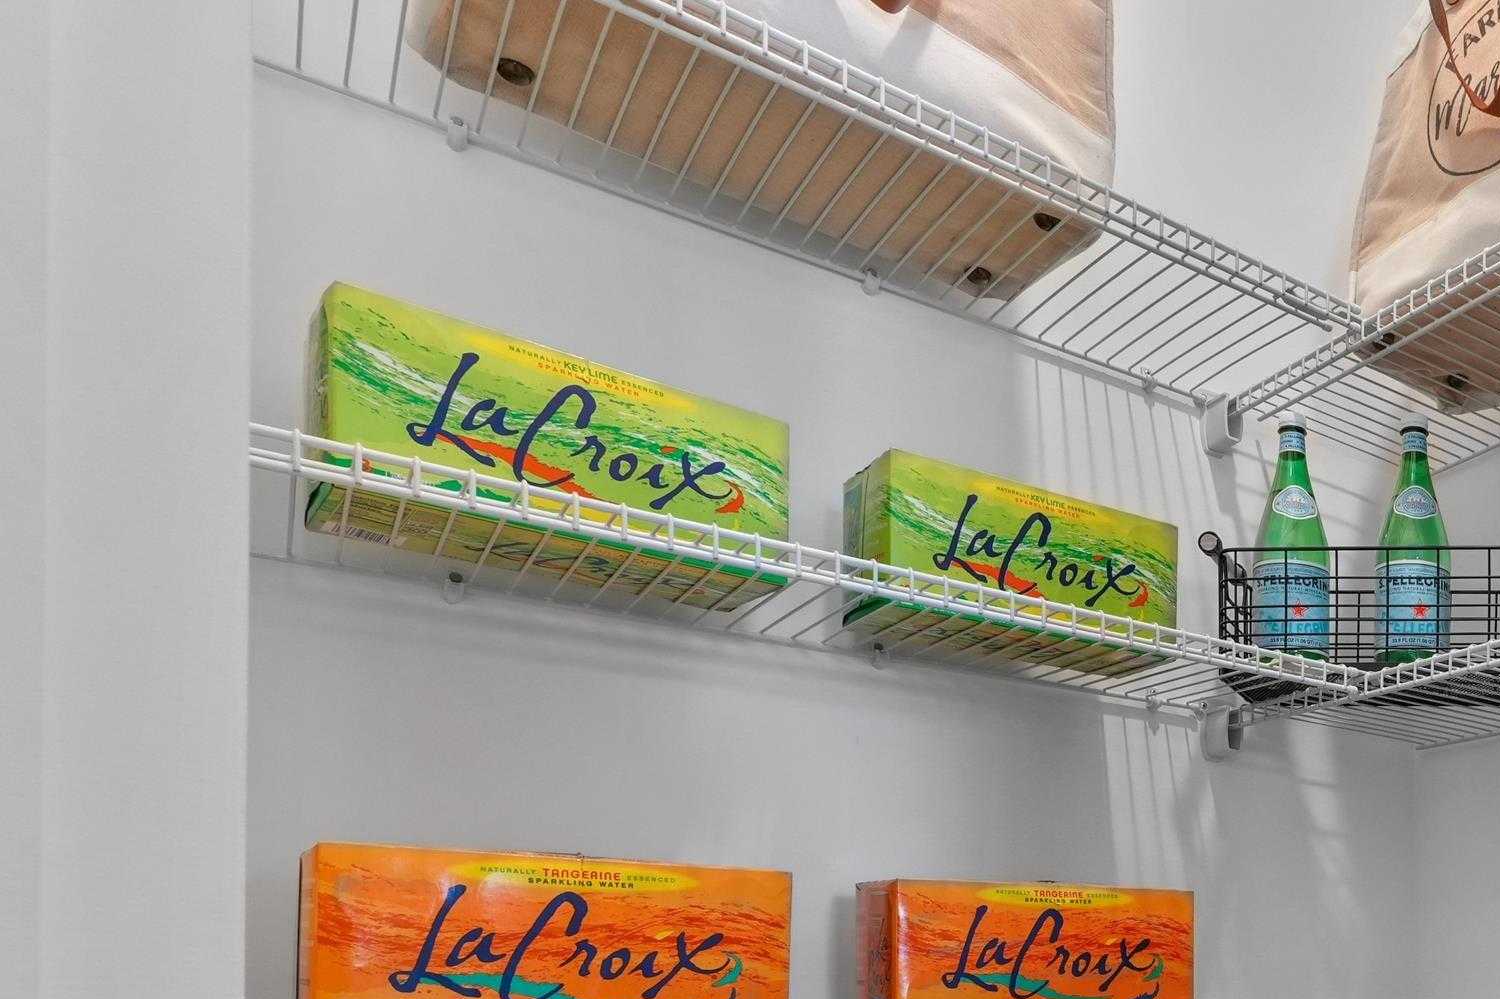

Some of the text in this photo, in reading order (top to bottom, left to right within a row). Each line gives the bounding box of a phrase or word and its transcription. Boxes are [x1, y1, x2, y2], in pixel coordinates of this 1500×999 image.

[564, 360, 586, 373] KEY
[588, 369, 618, 384] LIME
[480, 866, 537, 875] NATURALLY
[543, 868, 622, 881] TANGERINE
[528, 877, 635, 889] SPARKLING WATER
[1033, 889, 1083, 899] TANGERINE
